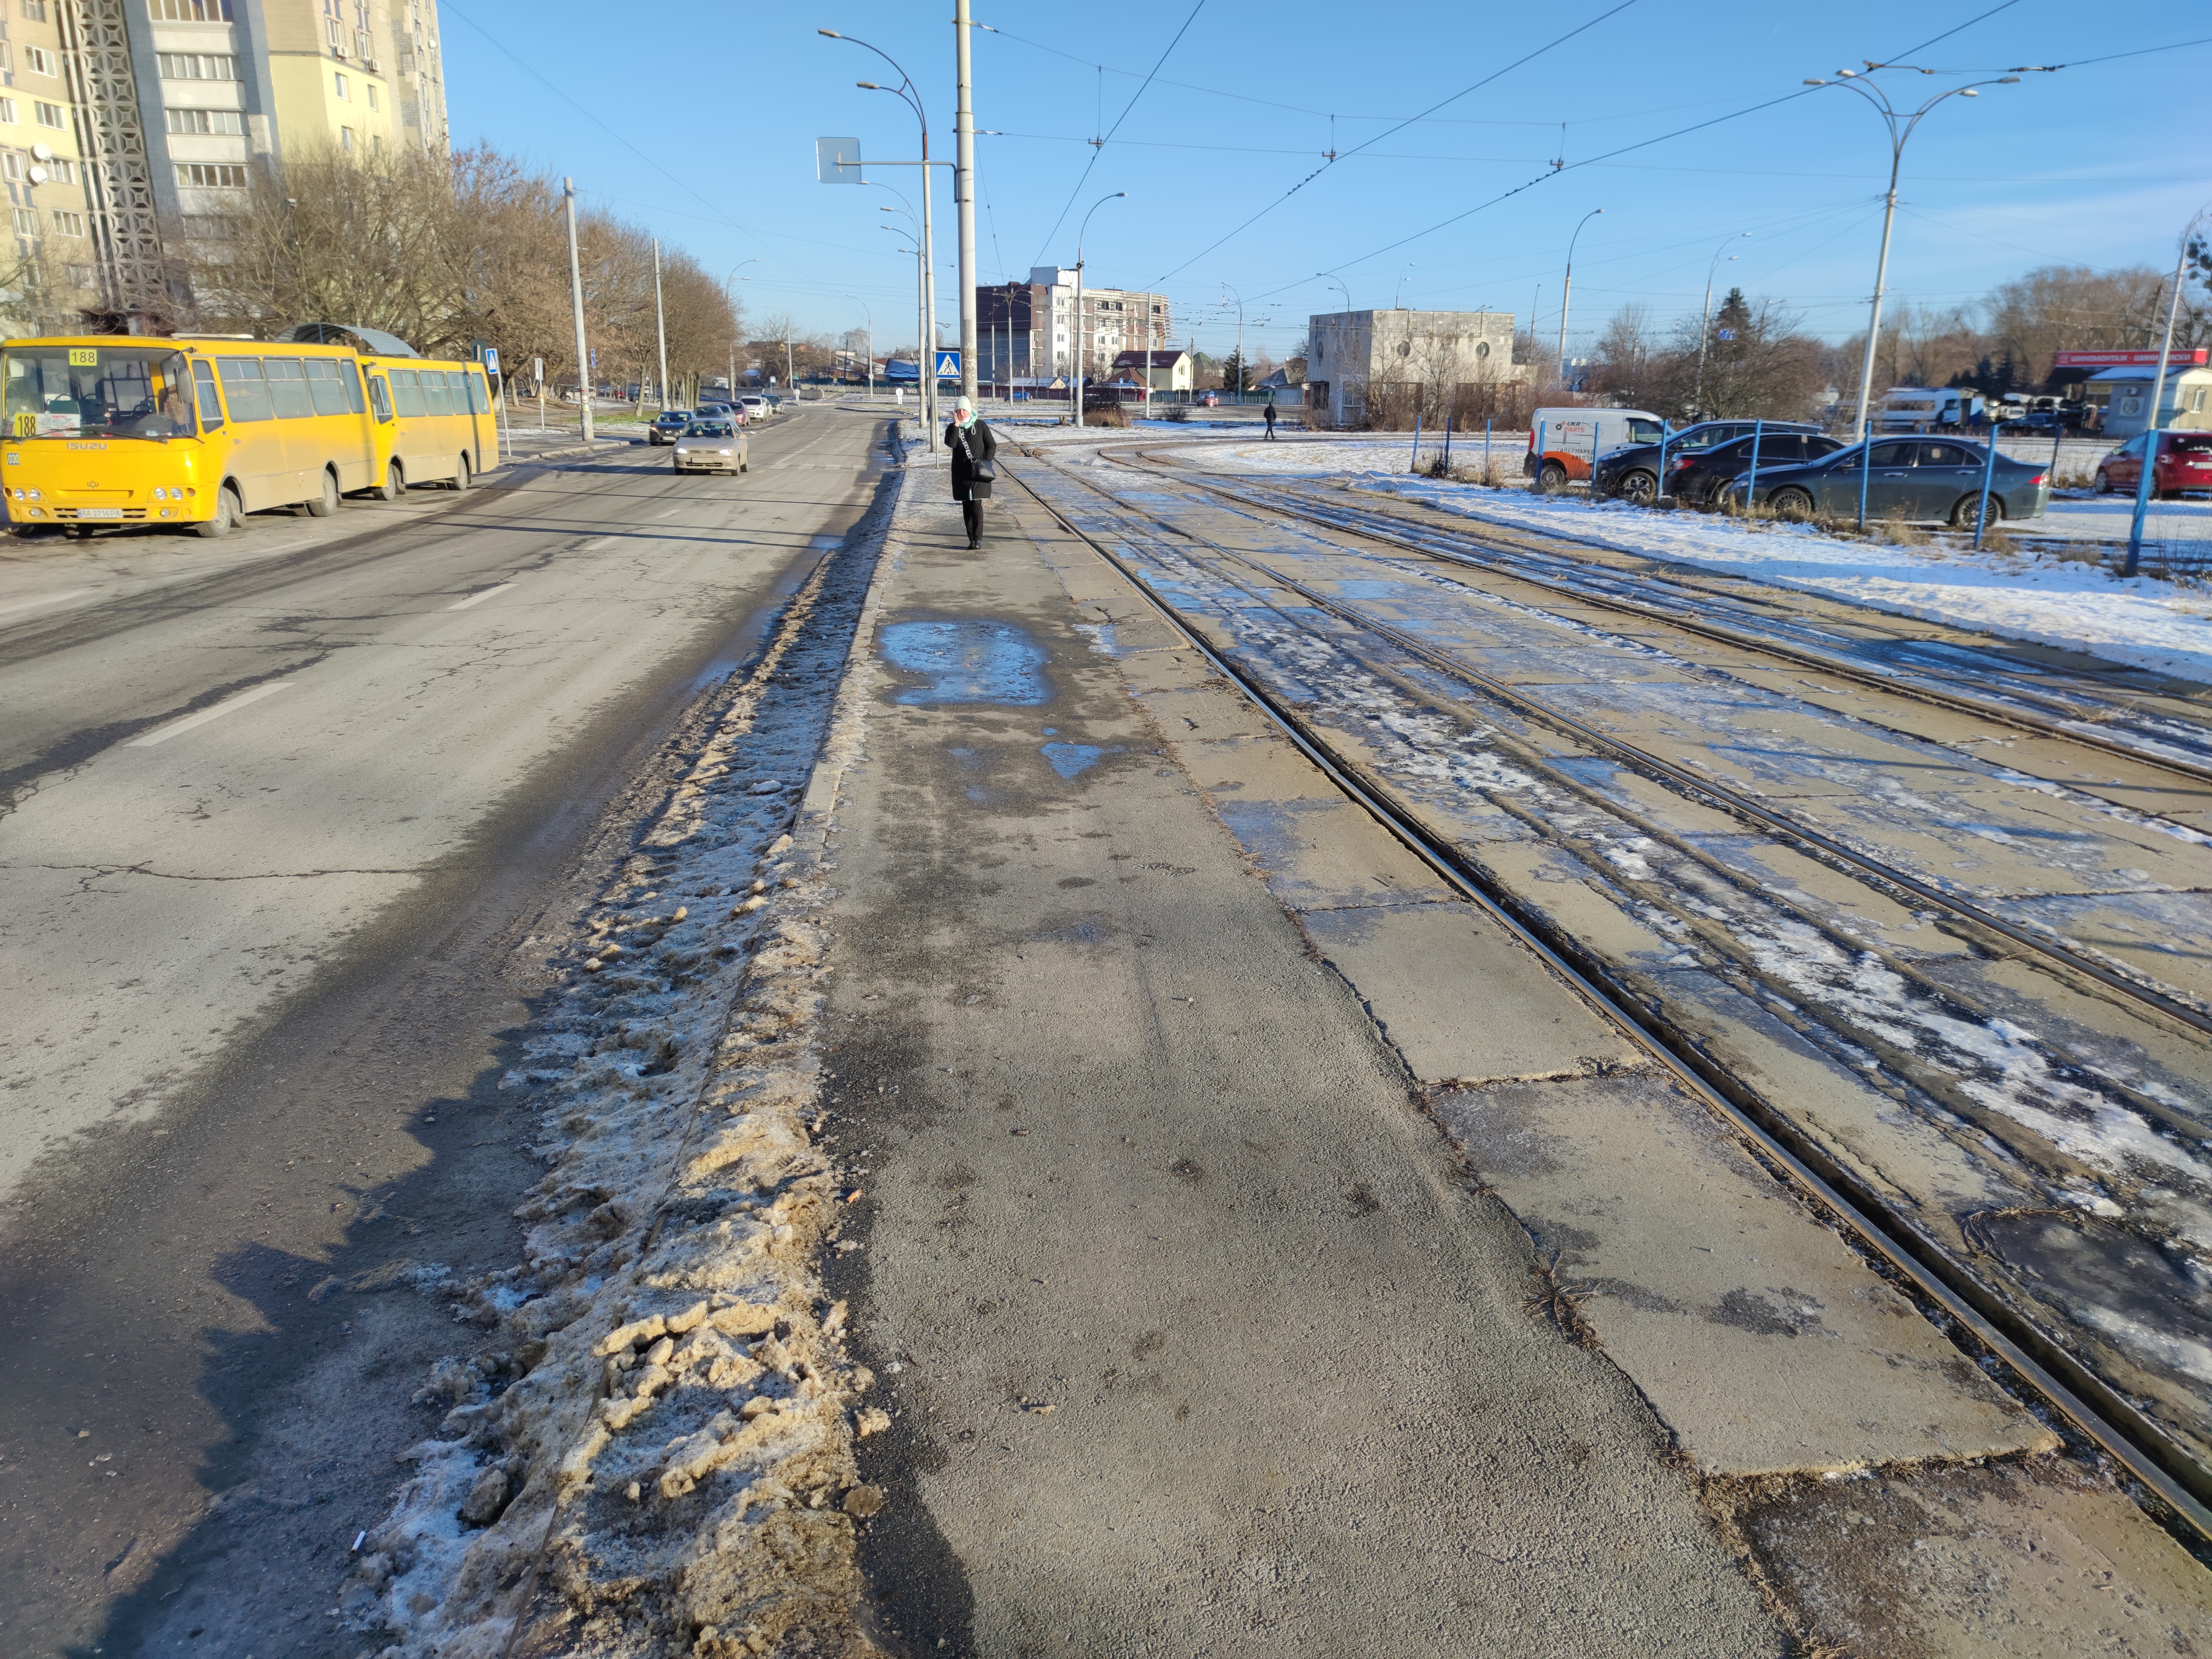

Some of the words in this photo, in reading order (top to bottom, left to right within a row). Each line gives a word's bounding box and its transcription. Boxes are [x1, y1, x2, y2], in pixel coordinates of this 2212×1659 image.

[71, 351, 95, 363] 188
[18, 415, 36, 437] 188
[8, 454, 19, 464] 030
